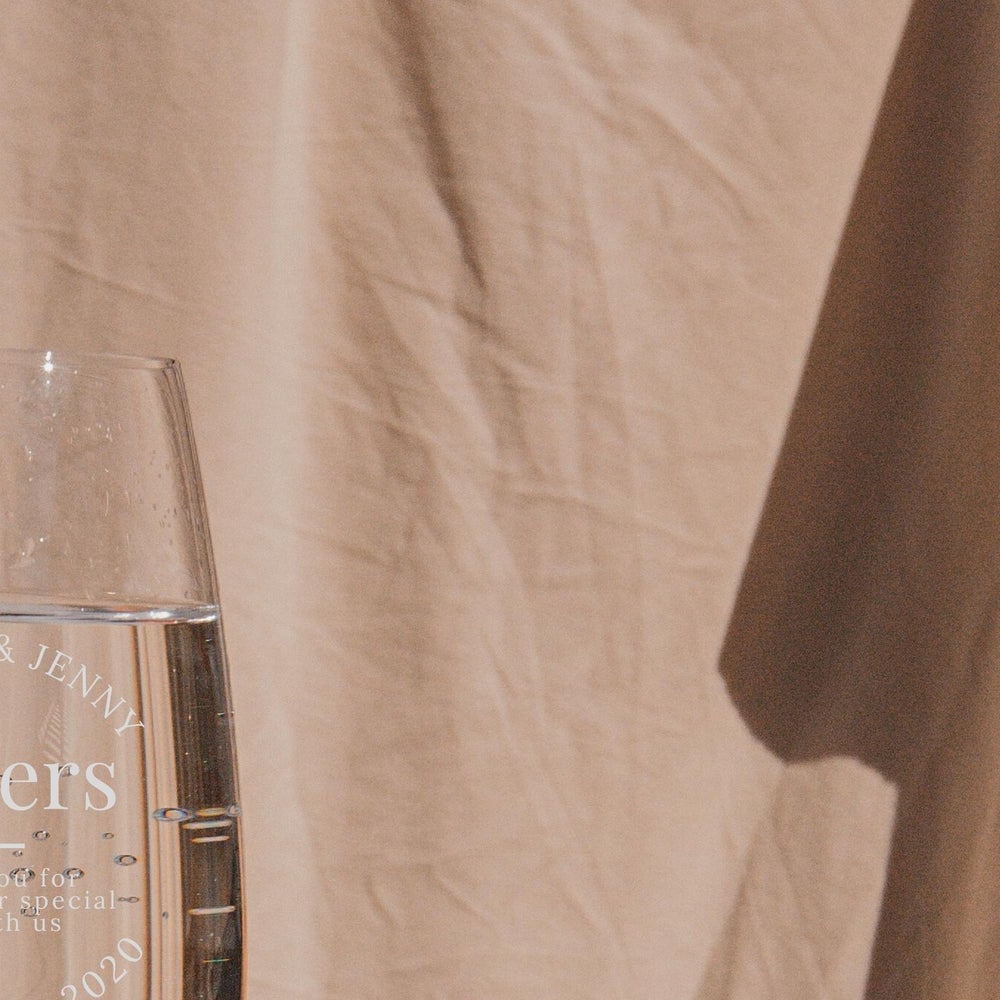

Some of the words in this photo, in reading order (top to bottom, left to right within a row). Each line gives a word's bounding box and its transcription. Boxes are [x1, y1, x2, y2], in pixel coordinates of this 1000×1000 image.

[28, 644, 145, 737] JENNY
[40, 867, 80, 888] for
[20, 891, 117, 914] special
[33, 917, 62, 932] us
